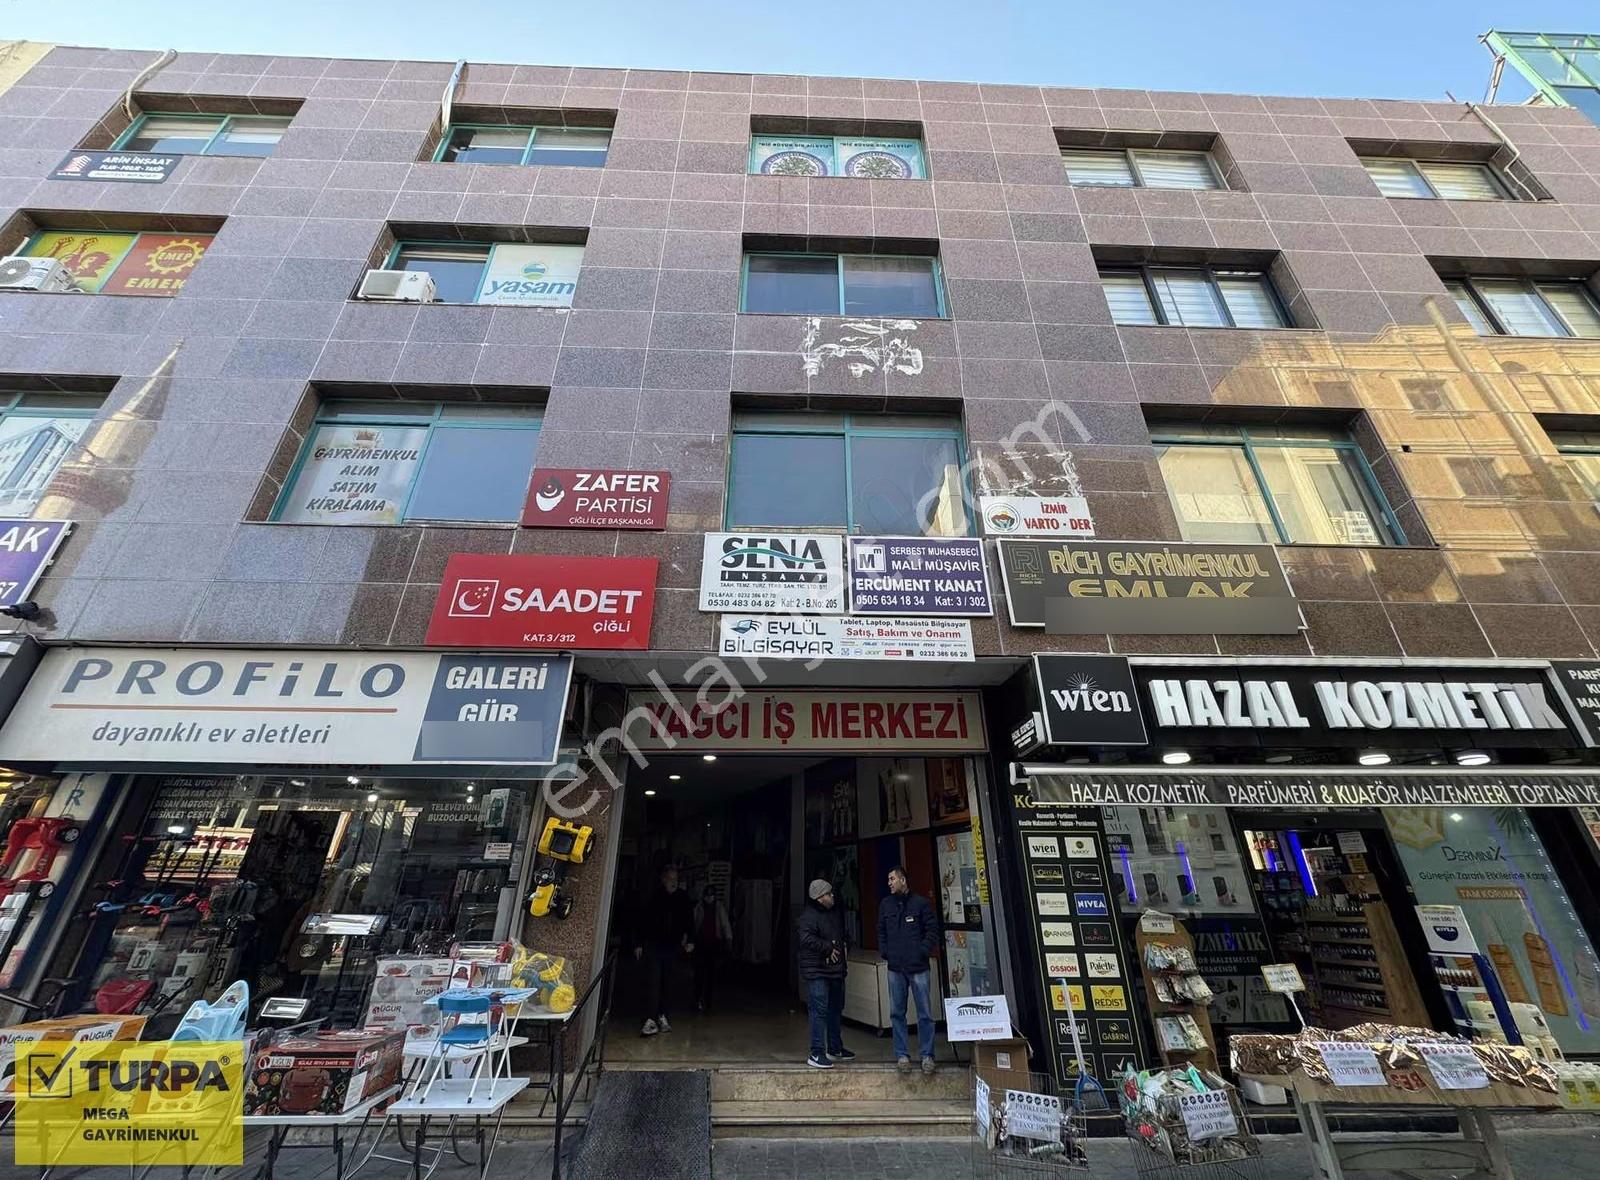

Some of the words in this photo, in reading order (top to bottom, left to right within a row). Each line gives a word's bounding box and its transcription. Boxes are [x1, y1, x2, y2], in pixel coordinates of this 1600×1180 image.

[484, 280, 576, 296] yaşam
[314, 447, 419, 461] GAYRİMENKUL
[339, 465, 380, 477] ALIM
[328, 482, 378, 494] SATIM
[572, 473, 660, 493] ZAFER
[305, 496, 386, 512] KİRALAMA
[575, 496, 652, 513] PARTİSİ
[1040, 501, 1068, 514] İZMİR
[568, 516, 589, 525] ÇİĞLİ
[590, 517, 607, 526] İLÇE
[607, 518, 654, 526] BAŞKANLIĞI
[1024, 518, 1060, 530] VARTO
[1069, 518, 1092, 531] DER
[720, 537, 827, 569] SENA
[890, 546, 925, 556] SERBEST
[927, 547, 979, 557] MUHASEBECİ
[891, 559, 921, 571] MALİ
[925, 559, 981, 573] MÜŞAVİR
[1048, 545, 1103, 575] RİCH
[1107, 547, 1270, 578] GAYRİMENKUL
[855, 576, 931, 592] ERCÜMENT
[934, 579, 983, 593] KANAT
[501, 587, 643, 614] SAADET
[707, 599, 730, 607] 0530
[764, 600, 776, 608] 82
[825, 600, 838, 609] 205
[856, 595, 879, 605] 0505
[880, 595, 897, 605] 634
[900, 596, 912, 605] 18
[913, 596, 926, 606] 34
[934, 596, 954, 606] Kat:
[955, 597, 962, 606] 3
[969, 597, 986, 607] 302
[592, 619, 631, 634] ÇİĞLİ
[767, 619, 827, 636] EYLÜL
[839, 618, 865, 626] Tablet,
[930, 620, 967, 629] Bilgisayar
[724, 636, 834, 655] BİLGİSAYAR
[876, 628, 908, 638] Bakım
[911, 630, 922, 638] ve
[925, 629, 961, 639] Onarım
[445, 662, 548, 690] GALERİ
[1050, 683, 1132, 712] wien
[1149, 679, 1310, 728] HAZAL
[457, 698, 519, 722] GÜR
[763, 696, 796, 745] İŞ
[811, 696, 969, 739] MERKEZİ
[92, 721, 200, 747] dayanıklı
[208, 728, 238, 744] ev
[242, 724, 332, 745] aletleri
[1069, 783, 1124, 804] HAZAL
[1126, 780, 1210, 804] KOZMETİK
[1227, 780, 1317, 804] PARFÜMERİ
[1320, 785, 1334, 804] &
[1334, 780, 1403, 804] KUAFÖR
[1403, 780, 1512, 804] MALZEMELERİ
[1509, 784, 1580, 804] TOPTAN
[1032, 844, 1056, 853] wien
[1077, 900, 1106, 908] NIVEA
[1094, 999, 1124, 1007] REDIST
[1059, 1022, 1087, 1035] Reul
